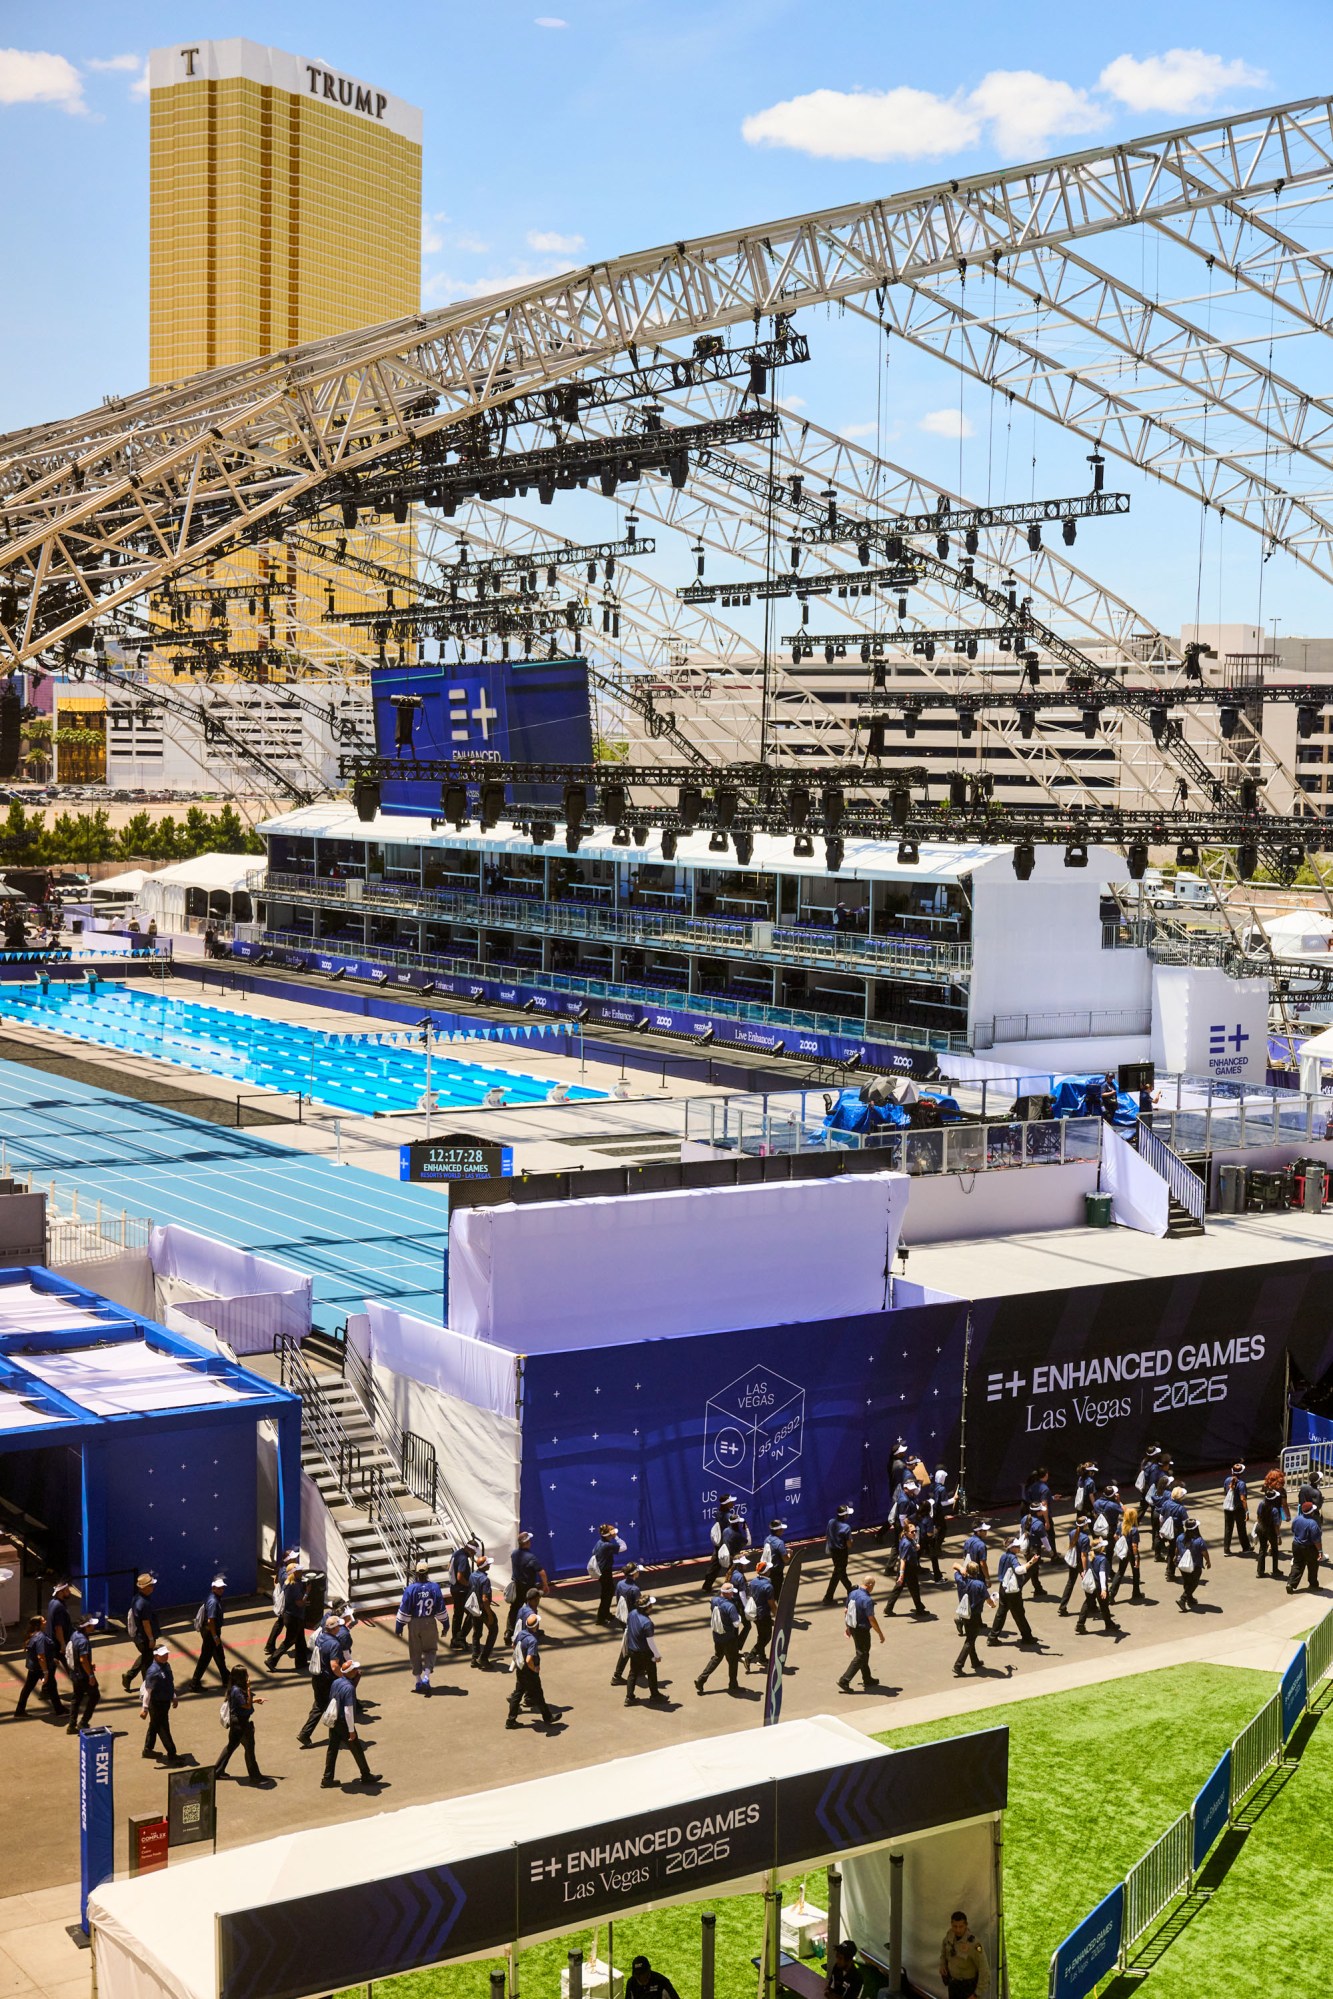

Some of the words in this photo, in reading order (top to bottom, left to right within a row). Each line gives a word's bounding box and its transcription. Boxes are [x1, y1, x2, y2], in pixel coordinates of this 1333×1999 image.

[181, 48, 199, 76] T
[306, 65, 388, 119] TRUMP
[602, 1007, 611, 1017] Live
[612, 1008, 635, 1021] Enhanced
[735, 1029, 747, 1040] Live
[747, 1031, 775, 1046] Enhanced
[1209, 1056, 1249, 1067] ENHANCED
[1215, 1066, 1242, 1075] GAMES
[429, 1149, 483, 1162] 12:17:28
[423, 1163, 462, 1172] ENHANCED
[463, 1164, 488, 1173] GAMES
[1032, 1349, 1172, 1395] ENHANCED
[1177, 1334, 1266, 1372] GAMES
[746, 1382, 767, 1396] LAS
[738, 1393, 775, 1409] VEGAS
[1025, 1404, 1067, 1432] Las
[1072, 1395, 1131, 1428] Vegas
[1153, 1374, 1229, 1413] 2026
[702, 1490, 718, 1503] US
[416, 1598, 434, 1617] 13
[567, 1826, 682, 1874] ENHANCED
[686, 1803, 760, 1841] GAMES
[563, 1879, 595, 1903] Las
[600, 1866, 650, 1892] Vegas
[666, 1837, 730, 1875] 2026
